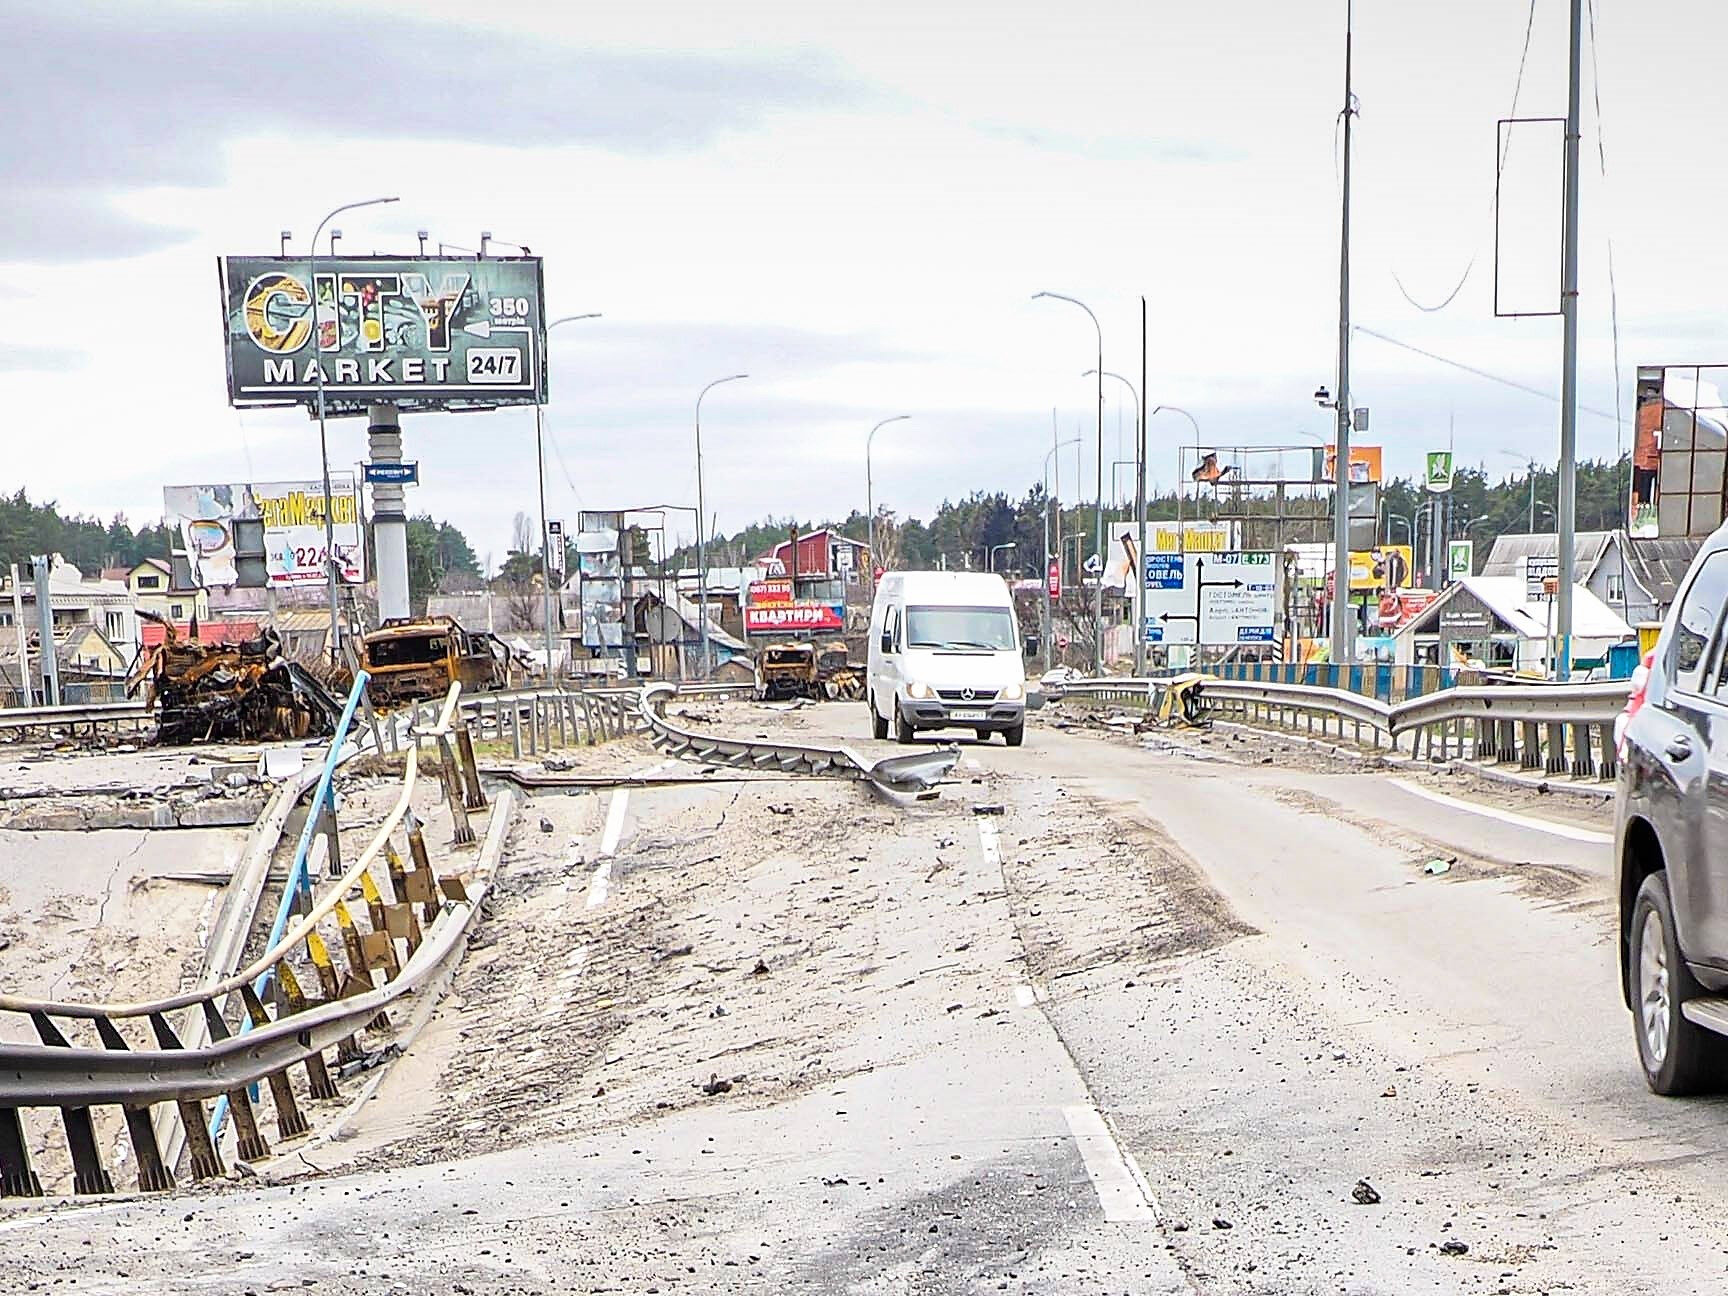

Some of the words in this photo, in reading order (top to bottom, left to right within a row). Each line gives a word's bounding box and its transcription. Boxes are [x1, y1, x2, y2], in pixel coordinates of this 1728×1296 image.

[243, 271, 471, 354] CITY
[489, 297, 529, 316] 350
[263, 358, 451, 384] MARKET
[471, 355, 517, 375] 24/7
[254, 491, 357, 530] егаМаркет
[1145, 569, 1183, 580] ОВЕЛЬ
[749, 608, 824, 625] КВАРТИРИ
